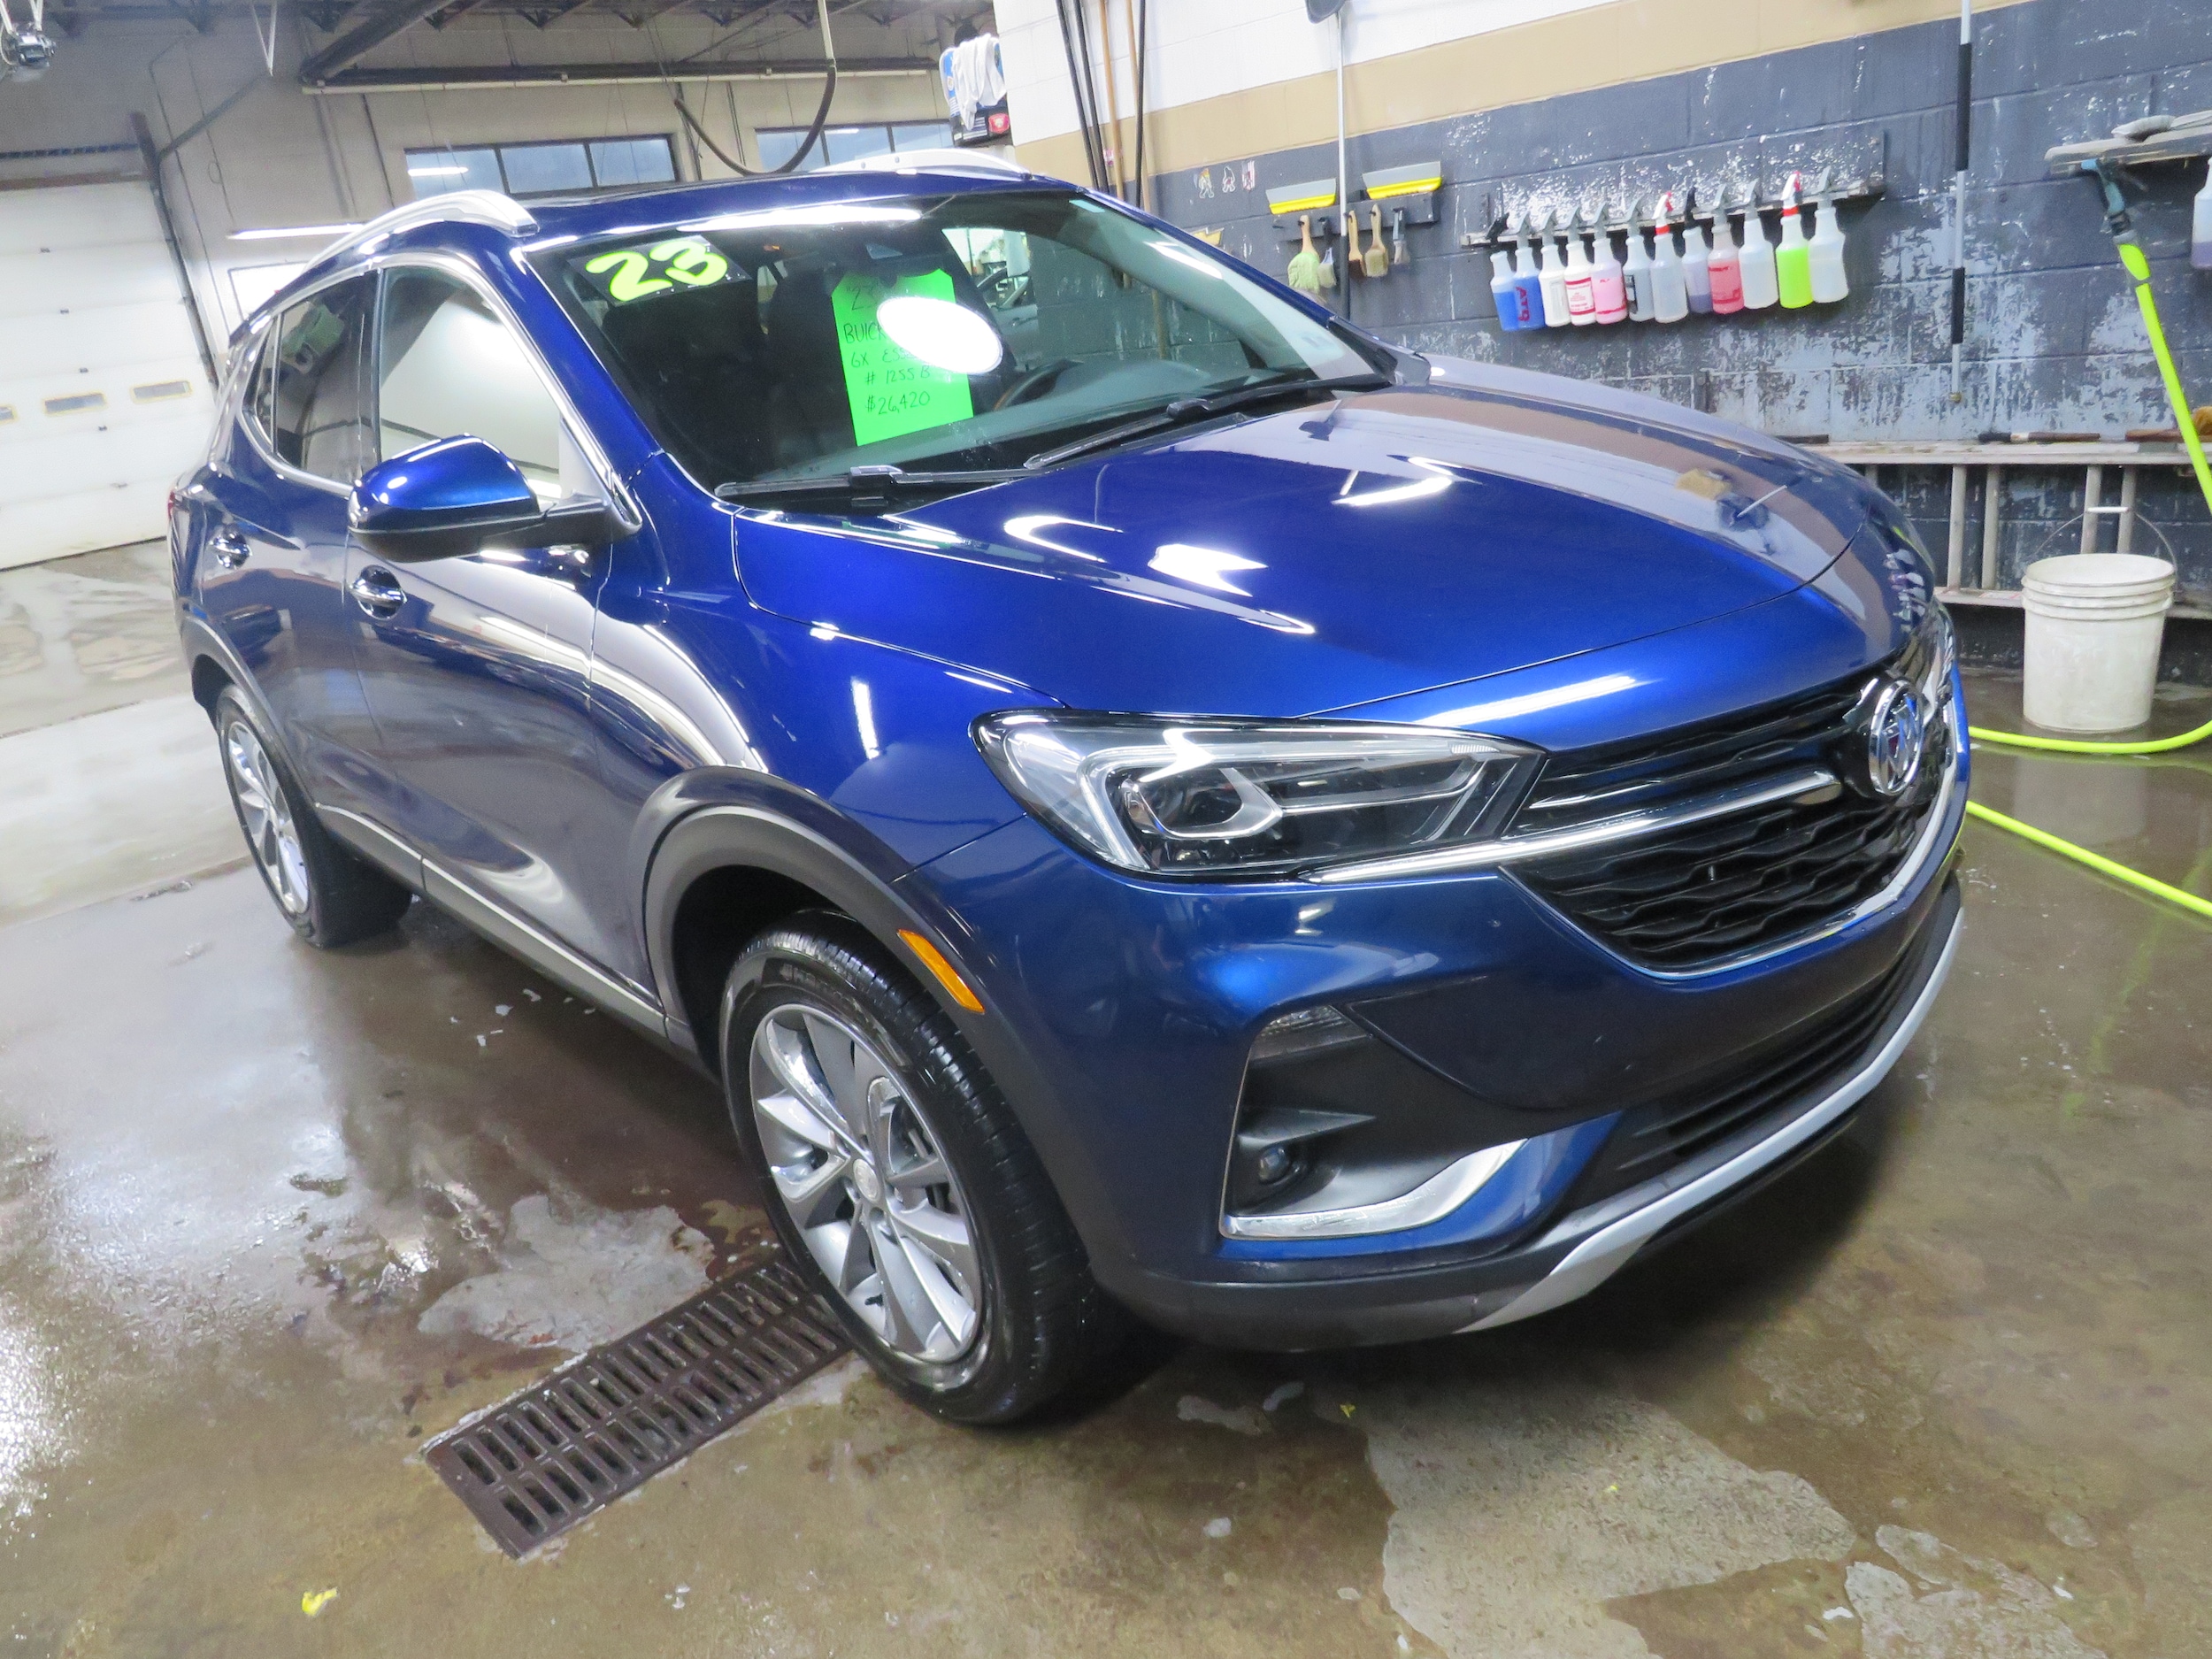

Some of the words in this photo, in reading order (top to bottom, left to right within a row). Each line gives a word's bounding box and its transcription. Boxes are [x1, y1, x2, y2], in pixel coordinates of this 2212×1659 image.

[586, 241, 728, 302] 23
[843, 322, 887, 344] BUICK
[865, 390, 931, 416] $26,420
